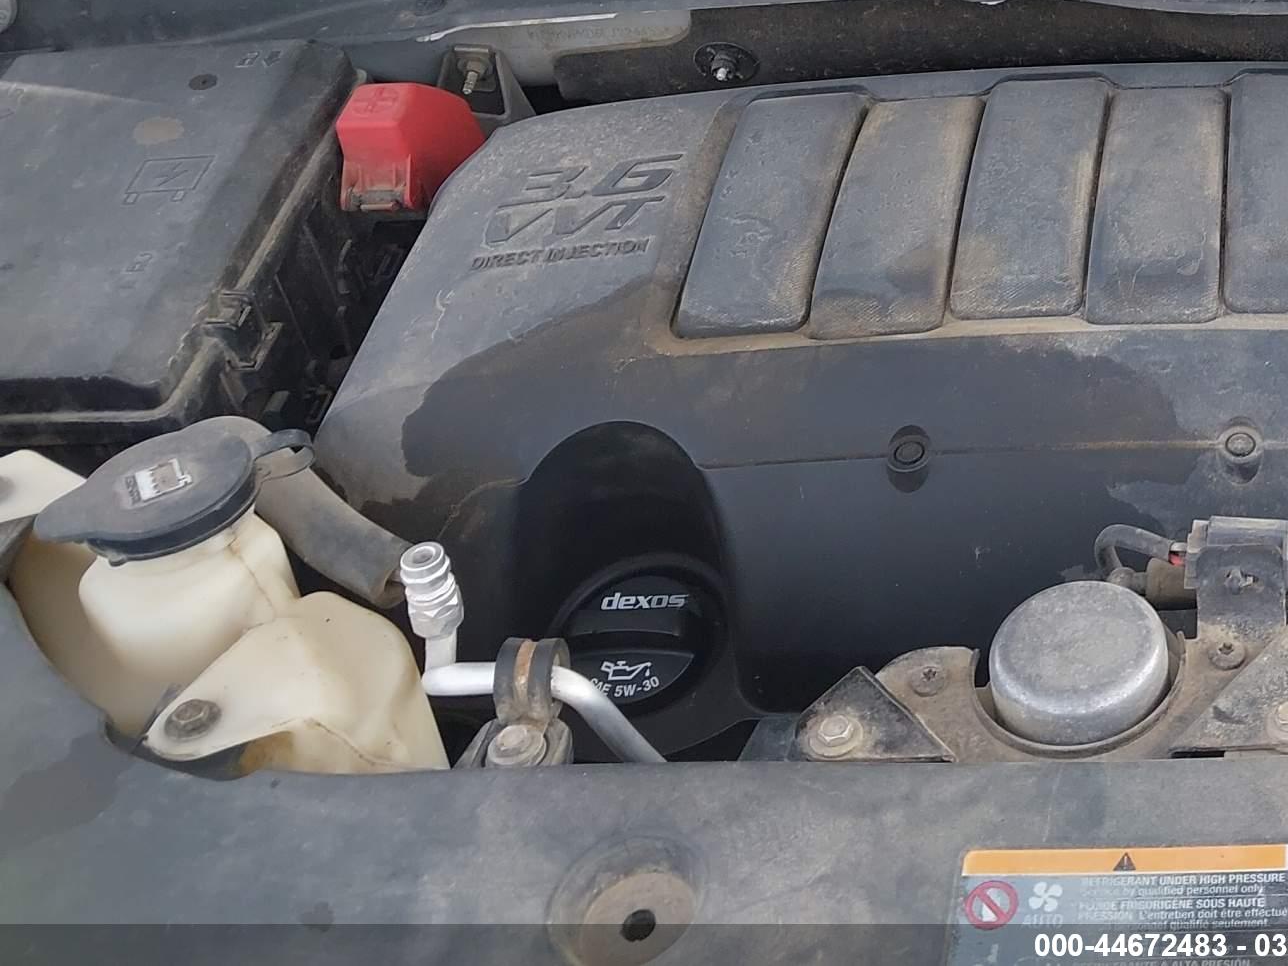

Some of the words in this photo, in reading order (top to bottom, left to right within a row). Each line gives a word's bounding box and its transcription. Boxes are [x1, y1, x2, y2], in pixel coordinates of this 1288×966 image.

[523, 153, 684, 202] 3.6
[483, 195, 666, 247] VVT
[471, 248, 540, 271] DIRECT
[542, 237, 650, 264] INJECTION
[600, 592, 690, 610] dexos
[613, 676, 660, 697] 5W-30
[1159, 875, 1197, 885] UNDER
[1199, 874, 1226, 884] HIGH
[1229, 873, 1286, 883] PRESSURE
[1138, 886, 1184, 897] qualified
[1186, 884, 1239, 896] personnel
[1196, 898, 1226, 909] SOUS
[1228, 896, 1265, 908] HAUTE
[1197, 908, 1218, 919] doit
